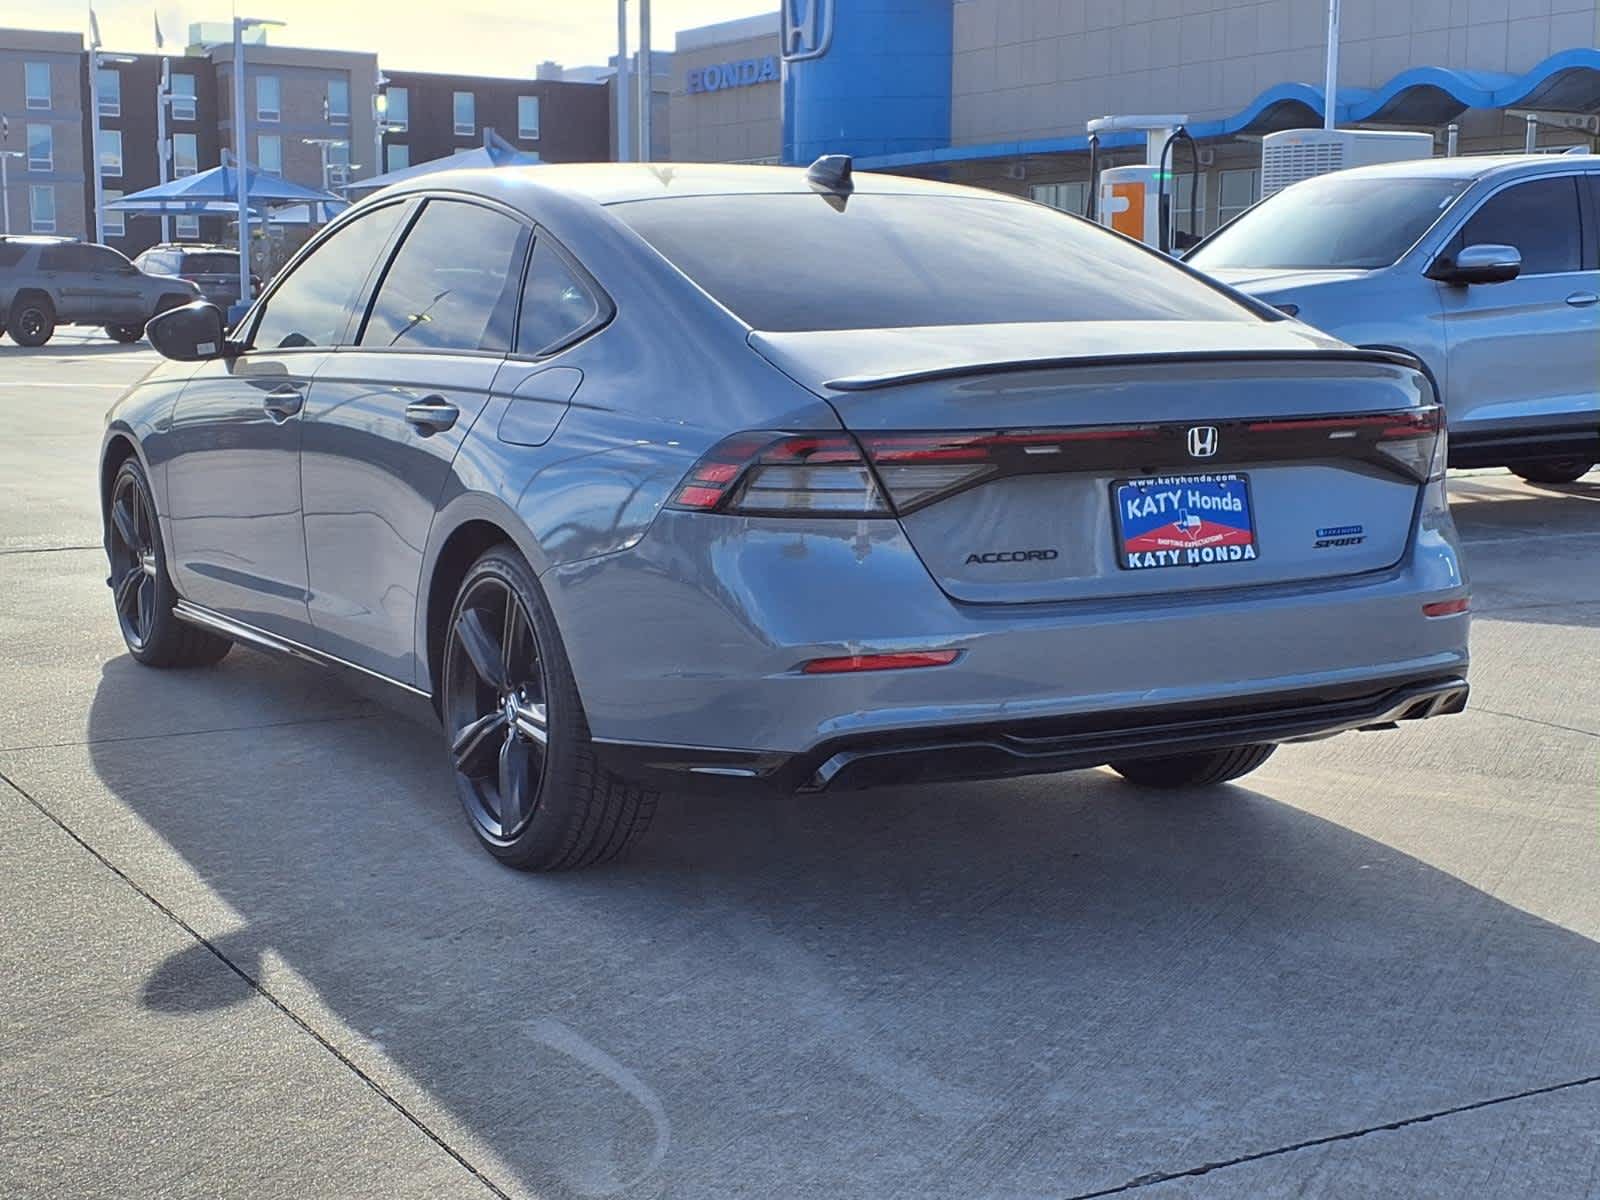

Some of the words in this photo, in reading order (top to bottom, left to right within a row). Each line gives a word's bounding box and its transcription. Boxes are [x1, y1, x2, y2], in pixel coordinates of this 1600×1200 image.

[687, 56, 778, 95] HONDA
[1128, 474, 1237, 486] www.katyhonda.com
[1127, 489, 1182, 519] KATY
[1188, 490, 1242, 512] Honda
[965, 550, 1059, 565] ACCORD
[1128, 551, 1180, 568] KATY
[1187, 544, 1256, 563] HONDA
